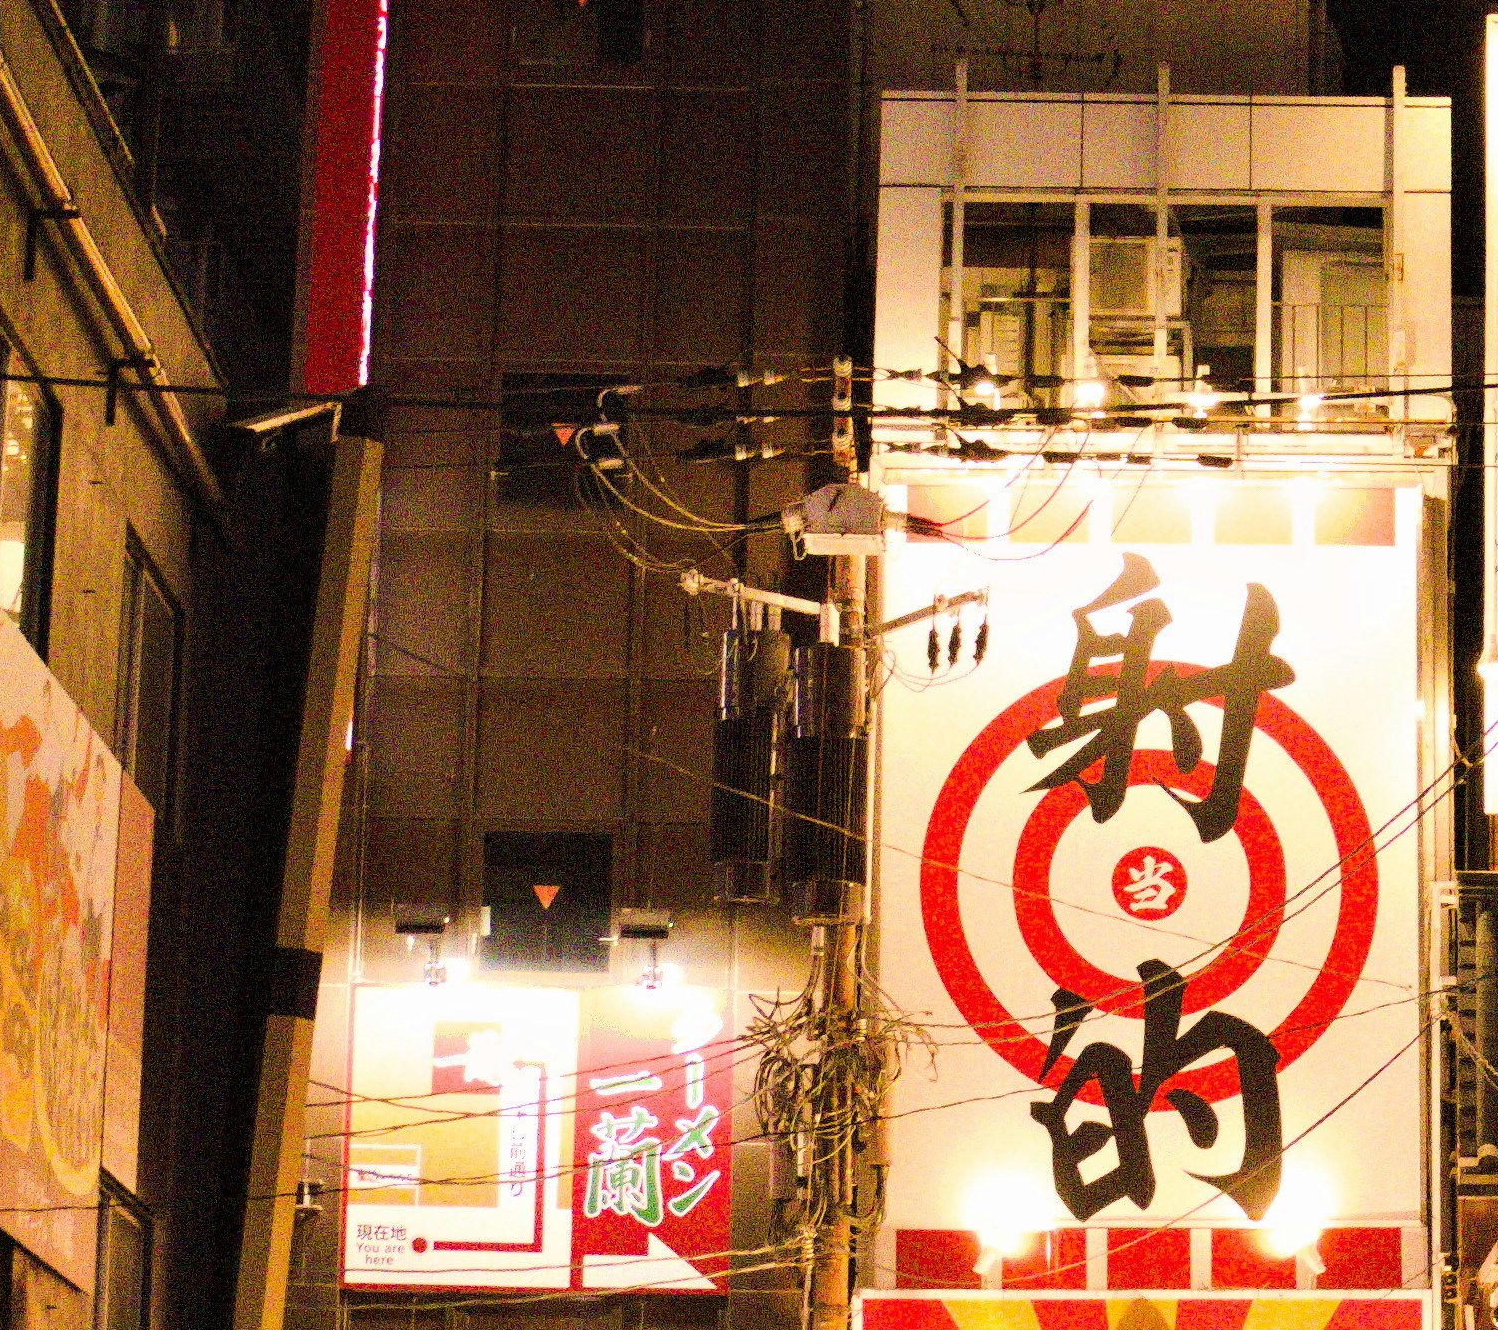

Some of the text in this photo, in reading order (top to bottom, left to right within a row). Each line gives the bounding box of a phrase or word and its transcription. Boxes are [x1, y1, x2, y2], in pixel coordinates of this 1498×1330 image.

[1122, 856, 1176, 912] 当
[585, 1070, 664, 1228] 一蘭
[356, 1223, 407, 1242] 現在地
[356, 1243, 405, 1255] You are
[365, 1254, 394, 1265] here
